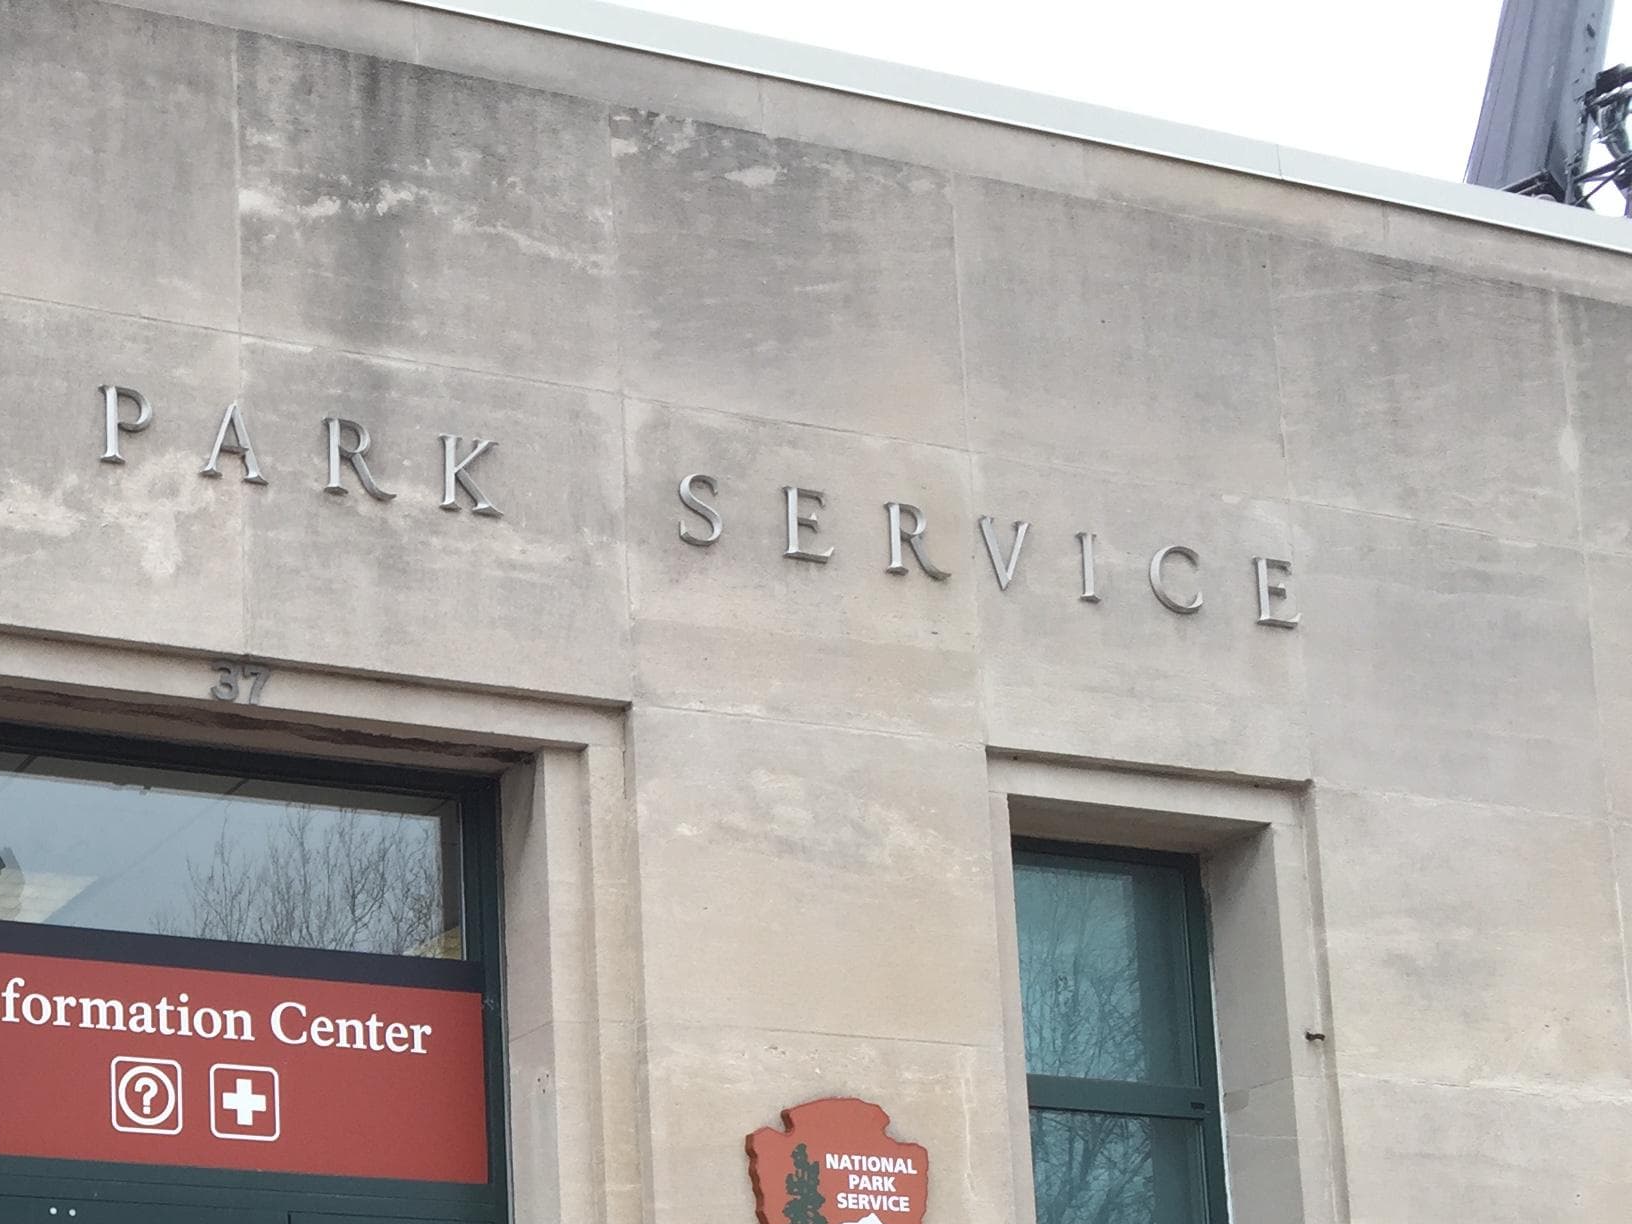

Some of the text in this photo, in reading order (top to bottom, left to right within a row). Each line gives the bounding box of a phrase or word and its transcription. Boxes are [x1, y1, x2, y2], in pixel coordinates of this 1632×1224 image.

[97, 384, 504, 518] PARK
[679, 473, 1302, 628] SERVICE
[210, 660, 270, 705] 37
[271, 1001, 432, 1054] Center
[825, 1153, 917, 1175] NATIONAL
[848, 1174, 896, 1193] PARK
[837, 1192, 910, 1212] SERVICE
